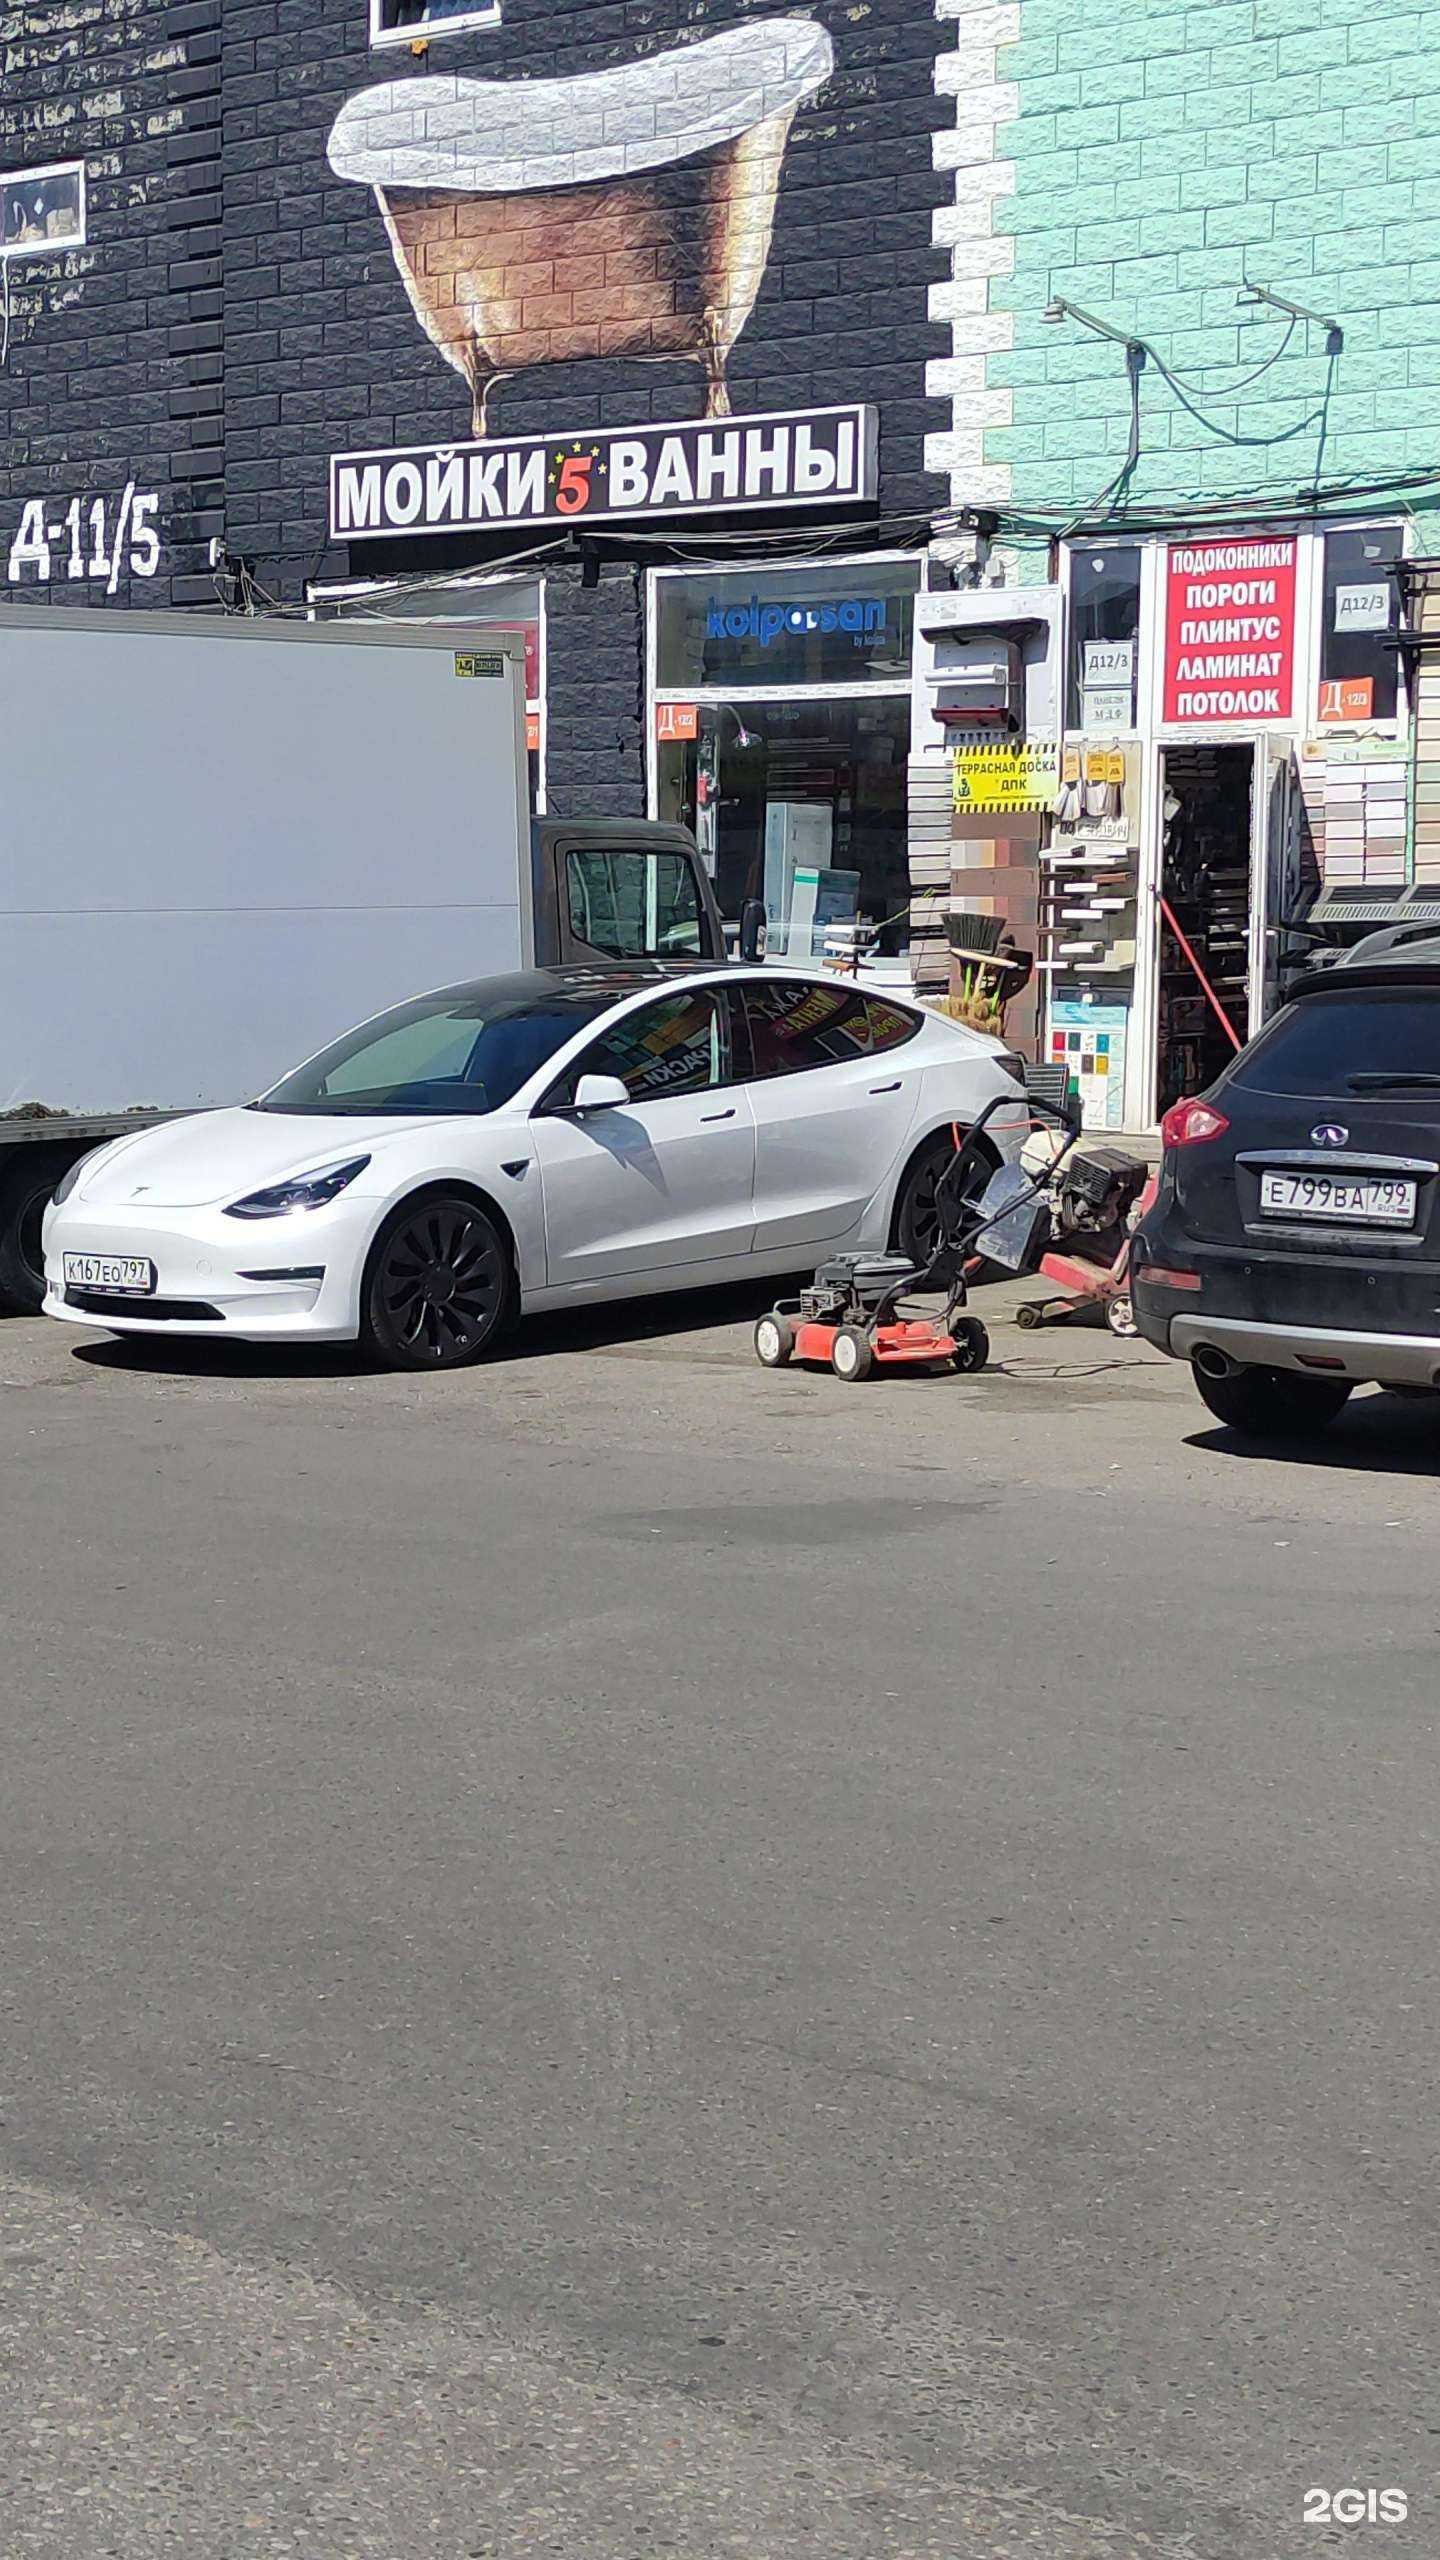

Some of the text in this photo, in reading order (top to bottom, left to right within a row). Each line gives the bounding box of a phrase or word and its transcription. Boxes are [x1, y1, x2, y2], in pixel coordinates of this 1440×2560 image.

[338, 421, 854, 529] МОЙКИ 5 ВАННЫ
[1172, 543, 1292, 576] ПОДОКОННИКИ
[1186, 580, 1276, 609] ПОРОГИ
[1341, 595, 1384, 614] Д12/3
[1181, 616, 1280, 645] ПЛИНТУС
[1089, 653, 1127, 670] Д12/3
[1176, 652, 1283, 681] ЛАМИНАТ
[1178, 689, 1280, 716] ПОТОЛОК
[1018, 760, 1056, 775] ДОСКА
[1001, 779, 1027, 792] ДПК
[1370, 1180, 1407, 1204] 799
[121, 1261, 145, 1279] 797
